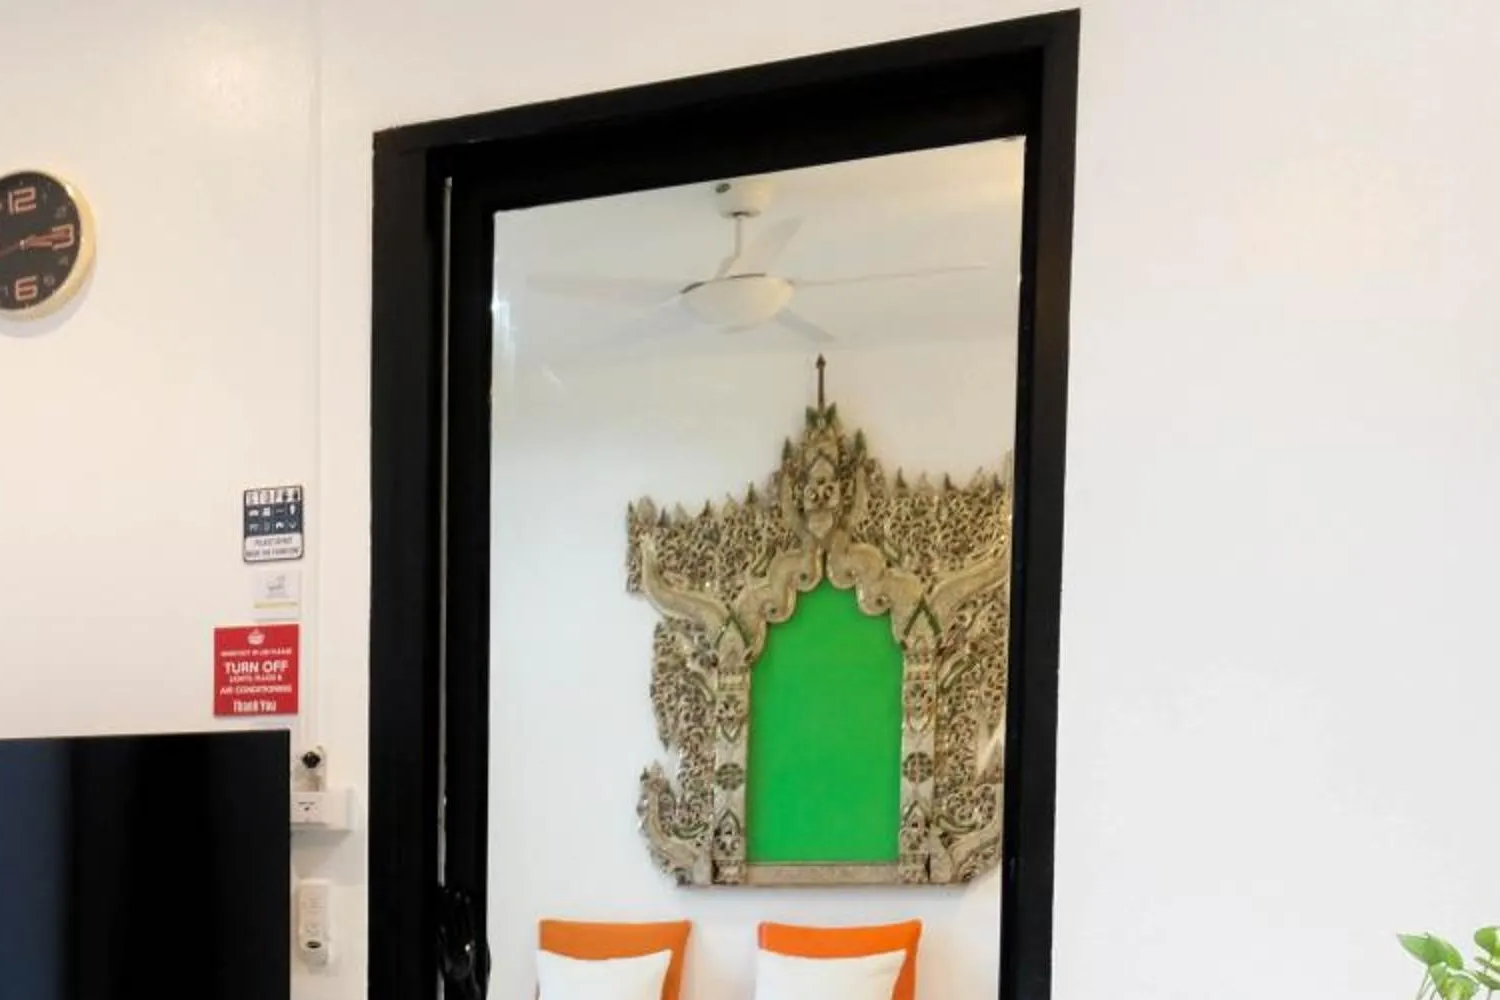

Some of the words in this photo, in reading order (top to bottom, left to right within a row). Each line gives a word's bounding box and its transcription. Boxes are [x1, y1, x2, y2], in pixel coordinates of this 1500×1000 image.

[8, 186, 36, 214] 12
[51, 224, 75, 250] 3
[15, 275, 38, 301] 6
[224, 660, 259, 674] TURN
[262, 658, 289, 672] OFF
